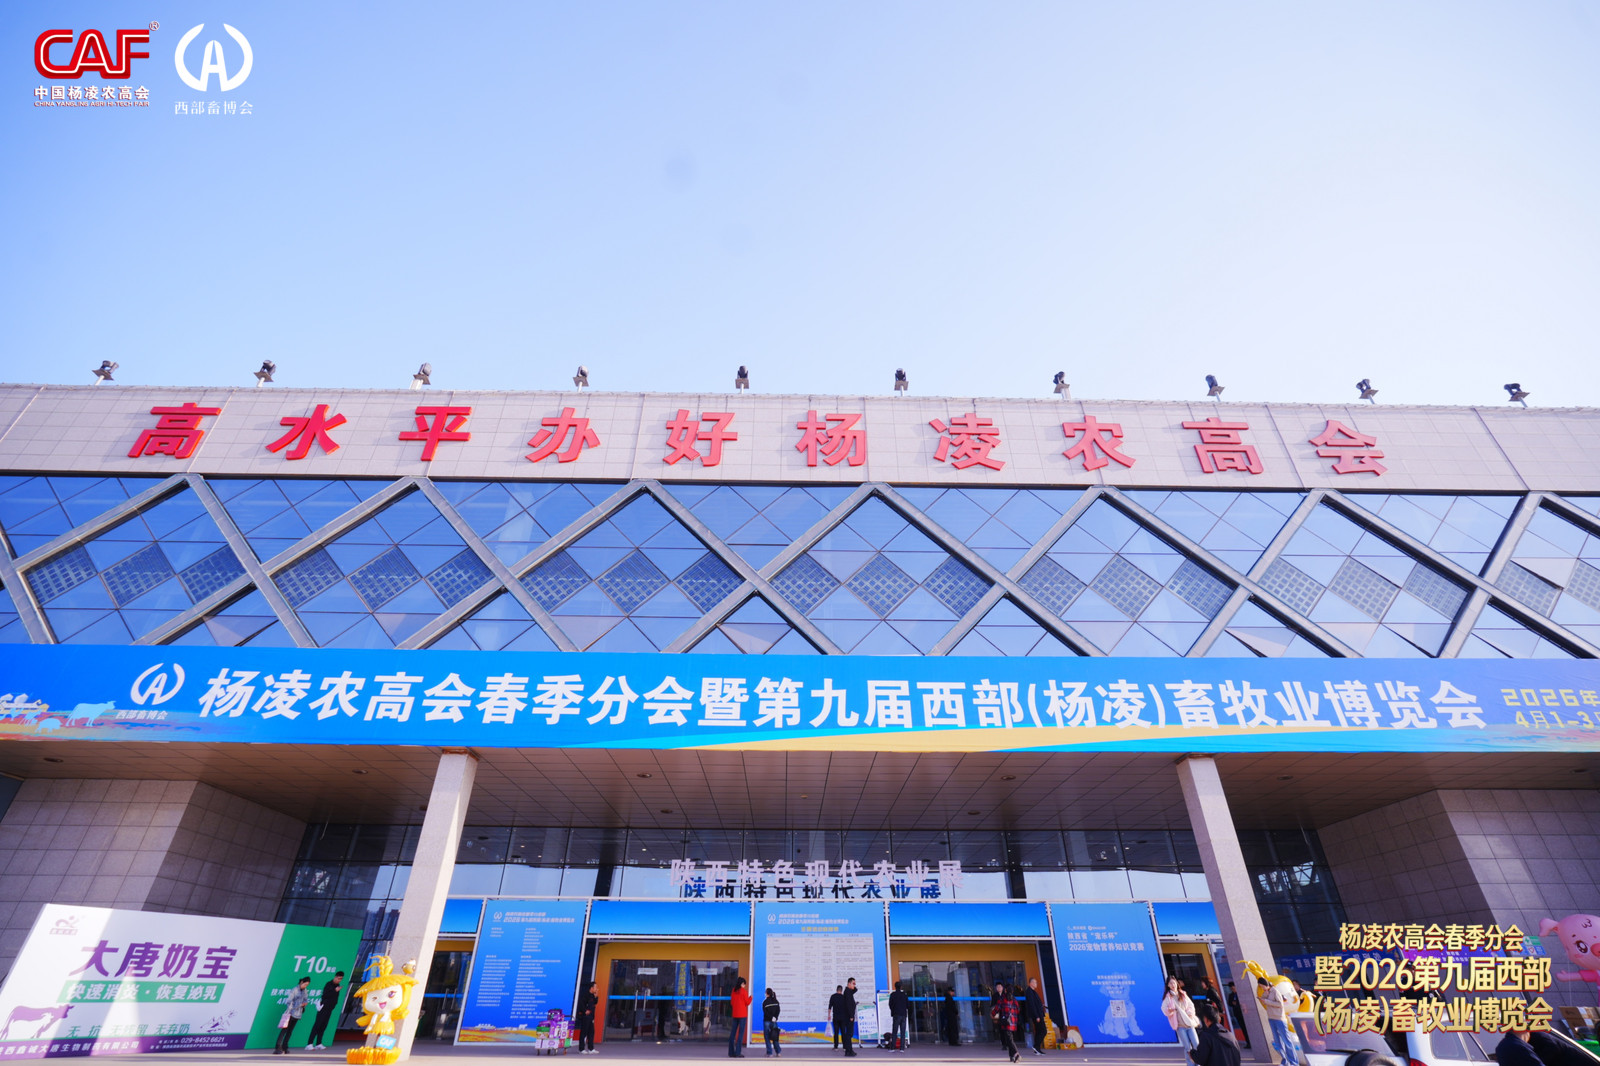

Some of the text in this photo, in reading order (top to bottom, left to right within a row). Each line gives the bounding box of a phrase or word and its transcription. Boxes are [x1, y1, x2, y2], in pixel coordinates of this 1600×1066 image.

[127, 402, 1389, 476] 高水平办好杨凌农高会
[115, 709, 169, 720] 西部畜博会
[198, 668, 1487, 730] 杨凌农高会春季分会暨第九届西部(杨凌)畜牧业博览会
[1500, 689, 1600, 706] 2026年
[669, 858, 965, 888] 陕西特色现代农业展
[69, 940, 238, 979] 大唐奶宝
